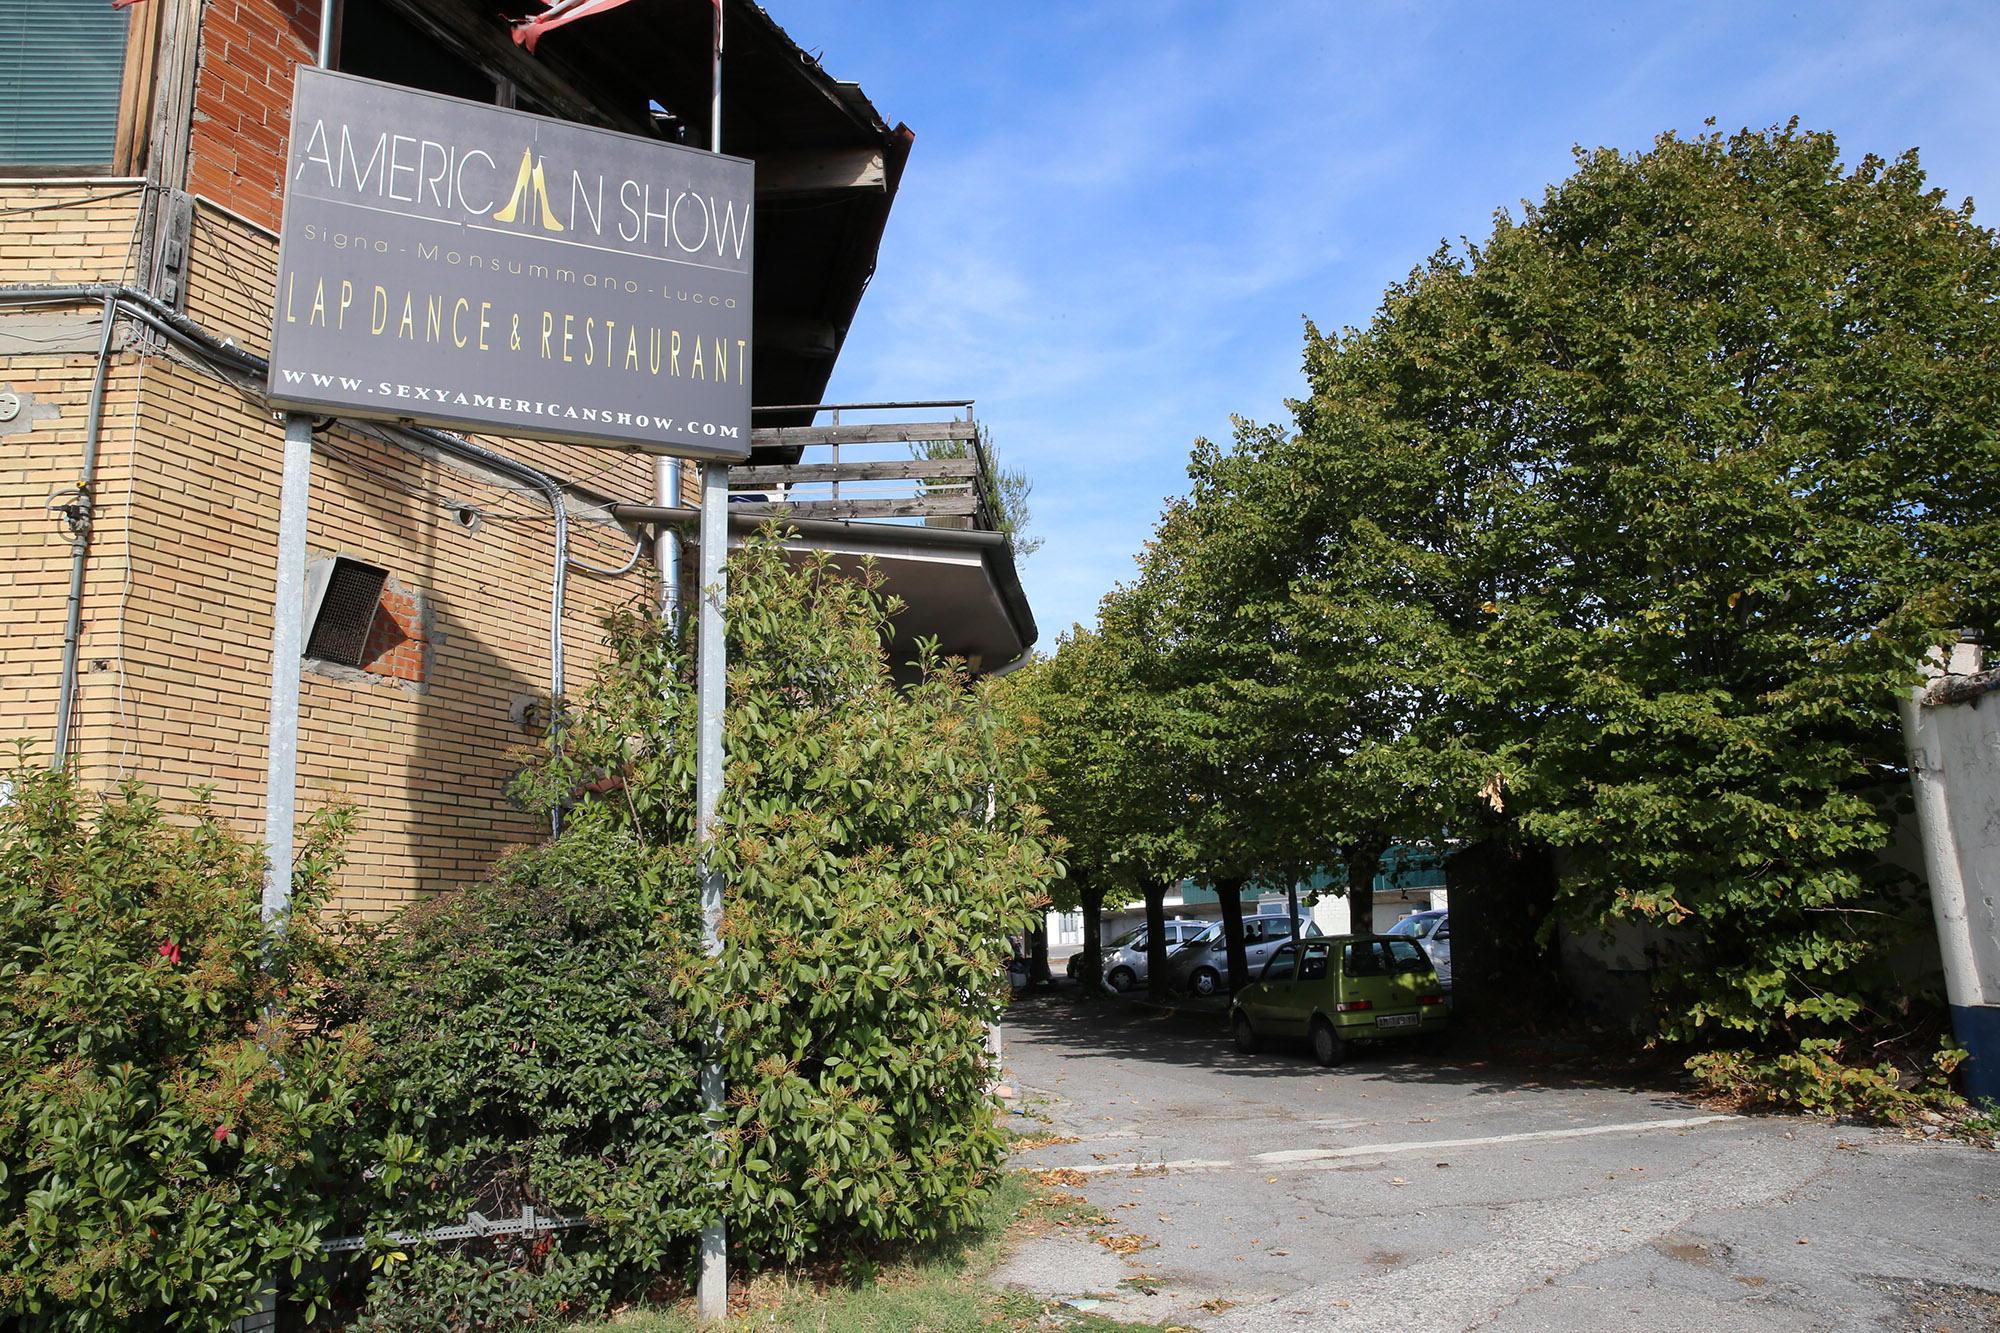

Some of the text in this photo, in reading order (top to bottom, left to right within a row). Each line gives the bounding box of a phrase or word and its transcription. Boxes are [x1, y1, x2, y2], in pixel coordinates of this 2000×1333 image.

[618, 179, 750, 260] SHOW
[304, 224, 389, 253] Signa
[417, 242, 638, 293] Monsummano
[663, 285, 737, 309] Lucca
[286, 271, 747, 386] LAP DANCE & RESTAURANT
[282, 369, 739, 439] WWW.SEXYAMERICANSHOW.COM
